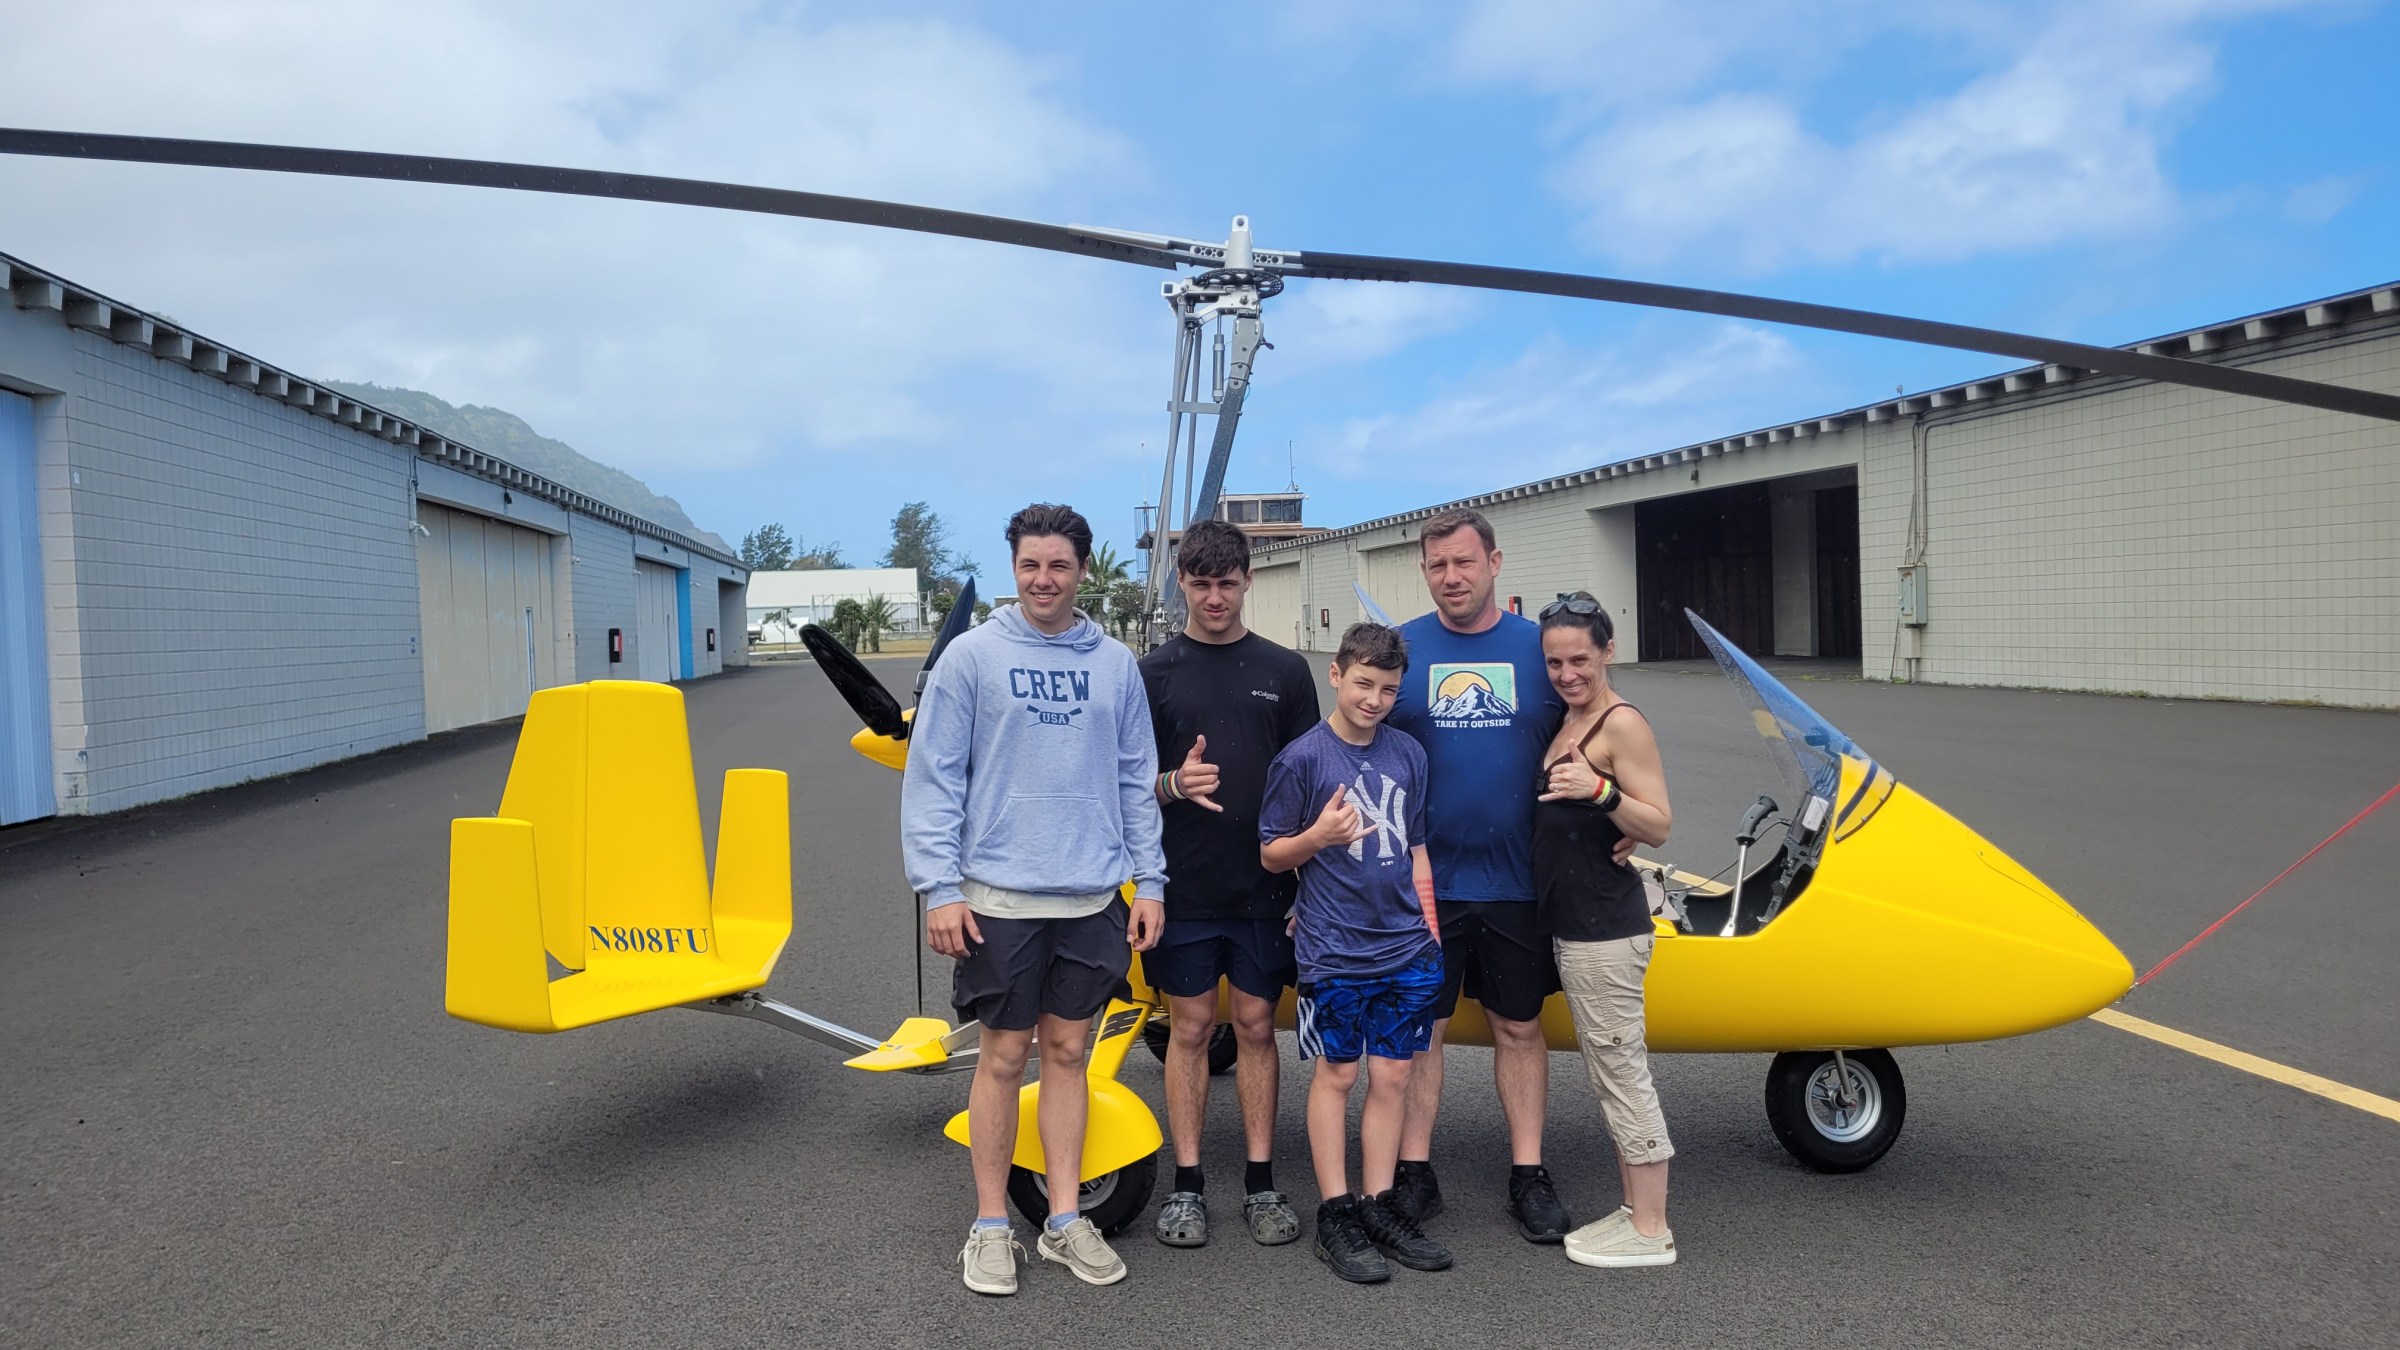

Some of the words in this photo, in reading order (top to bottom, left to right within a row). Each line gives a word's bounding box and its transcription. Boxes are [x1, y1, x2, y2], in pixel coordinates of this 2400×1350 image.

[1009, 668, 1090, 702] CREW
[1042, 713, 1067, 724] USA
[1434, 720, 1458, 728] TAKE
[1459, 720, 1469, 728] IT
[1470, 719, 1511, 728] OUTSIDE
[587, 926, 709, 954] N808FU
